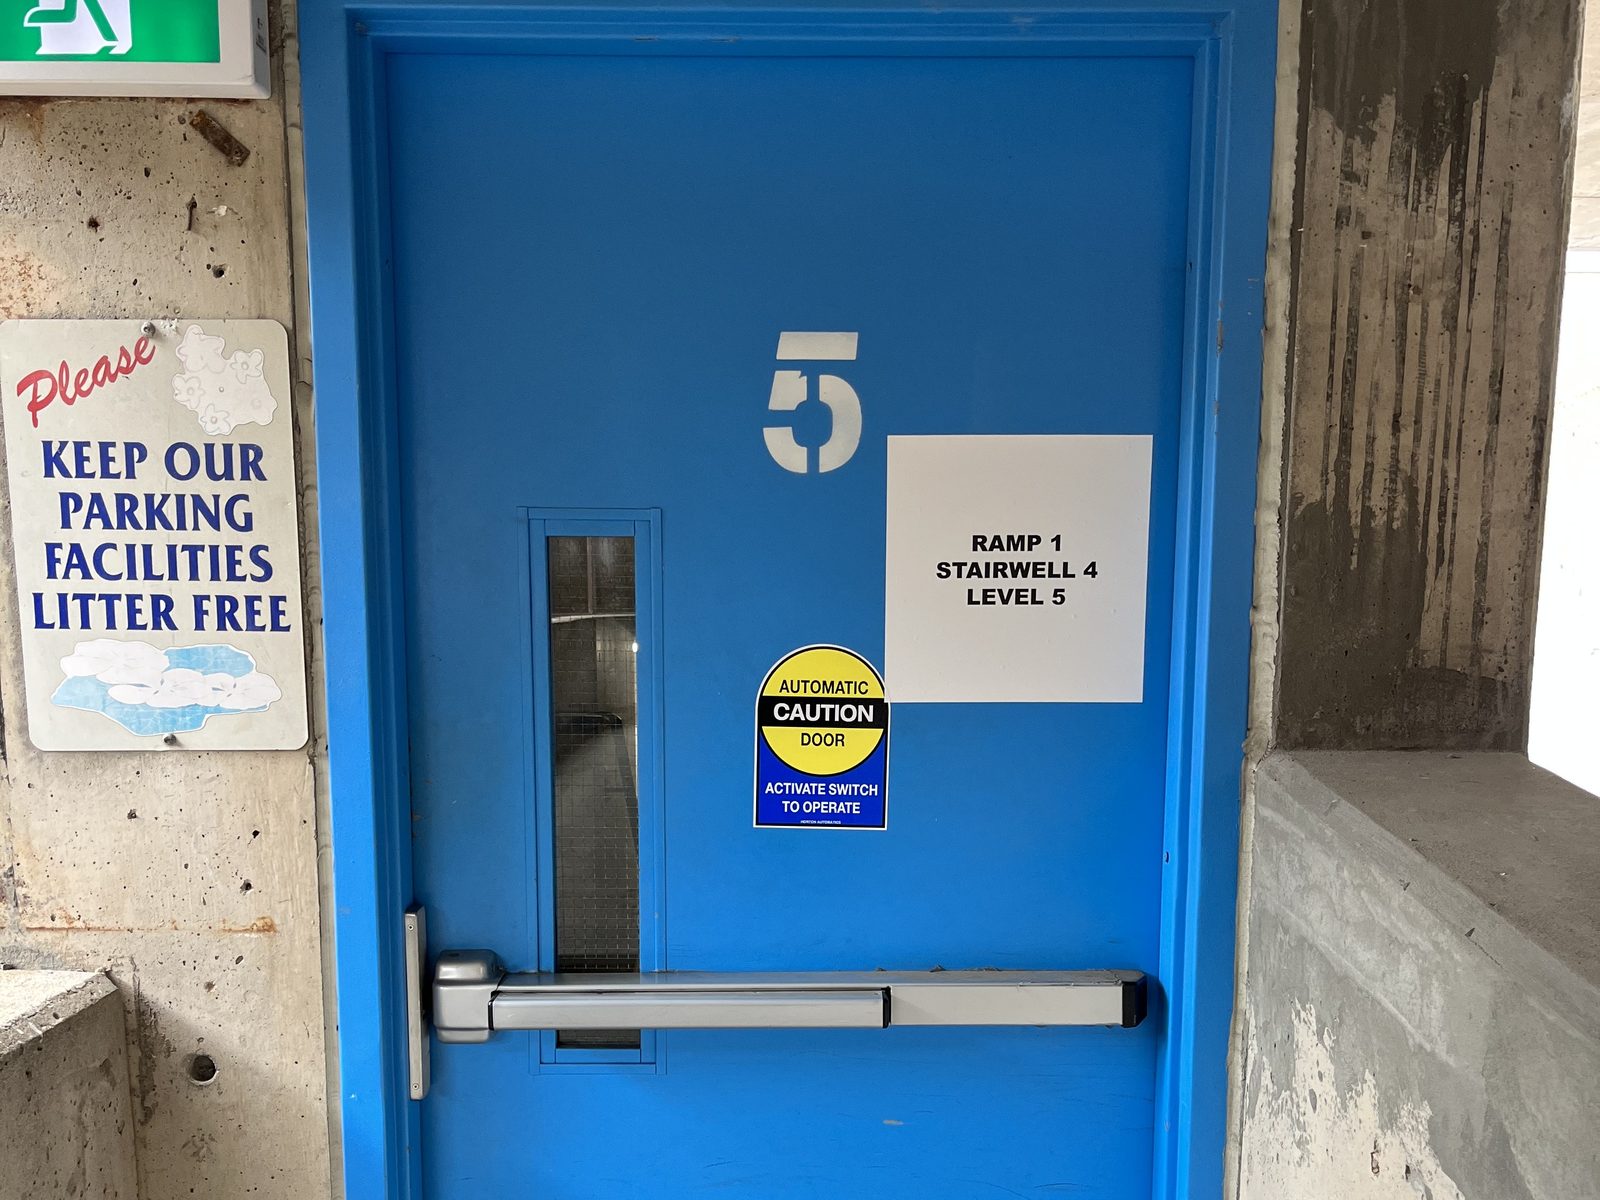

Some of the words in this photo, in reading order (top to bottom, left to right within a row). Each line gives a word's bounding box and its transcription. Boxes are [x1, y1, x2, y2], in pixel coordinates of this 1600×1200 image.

[16, 337, 155, 428] Please
[762, 331, 863, 474] 5
[42, 441, 148, 480] KEEP
[164, 442, 268, 482] OUR
[58, 492, 254, 533] PARKING
[971, 534, 1043, 552] RAMP
[1050, 534, 1062, 552] 1
[45, 542, 274, 583] FACILITIES
[936, 561, 1076, 579] STAIRWELL
[1083, 561, 1098, 579] 4
[967, 588, 1044, 606] LEVEL
[1051, 588, 1066, 606] 5
[32, 592, 179, 631] LITTER
[193, 595, 291, 632] FREE
[779, 680, 869, 695] AUTOMATIC
[773, 702, 874, 723] CAUTION
[800, 732, 846, 747] DOOR
[765, 782, 826, 795] ACTIVATE
[828, 783, 878, 796] SWITCH
[782, 800, 800, 813] TO
[802, 800, 861, 814] OPERATE
